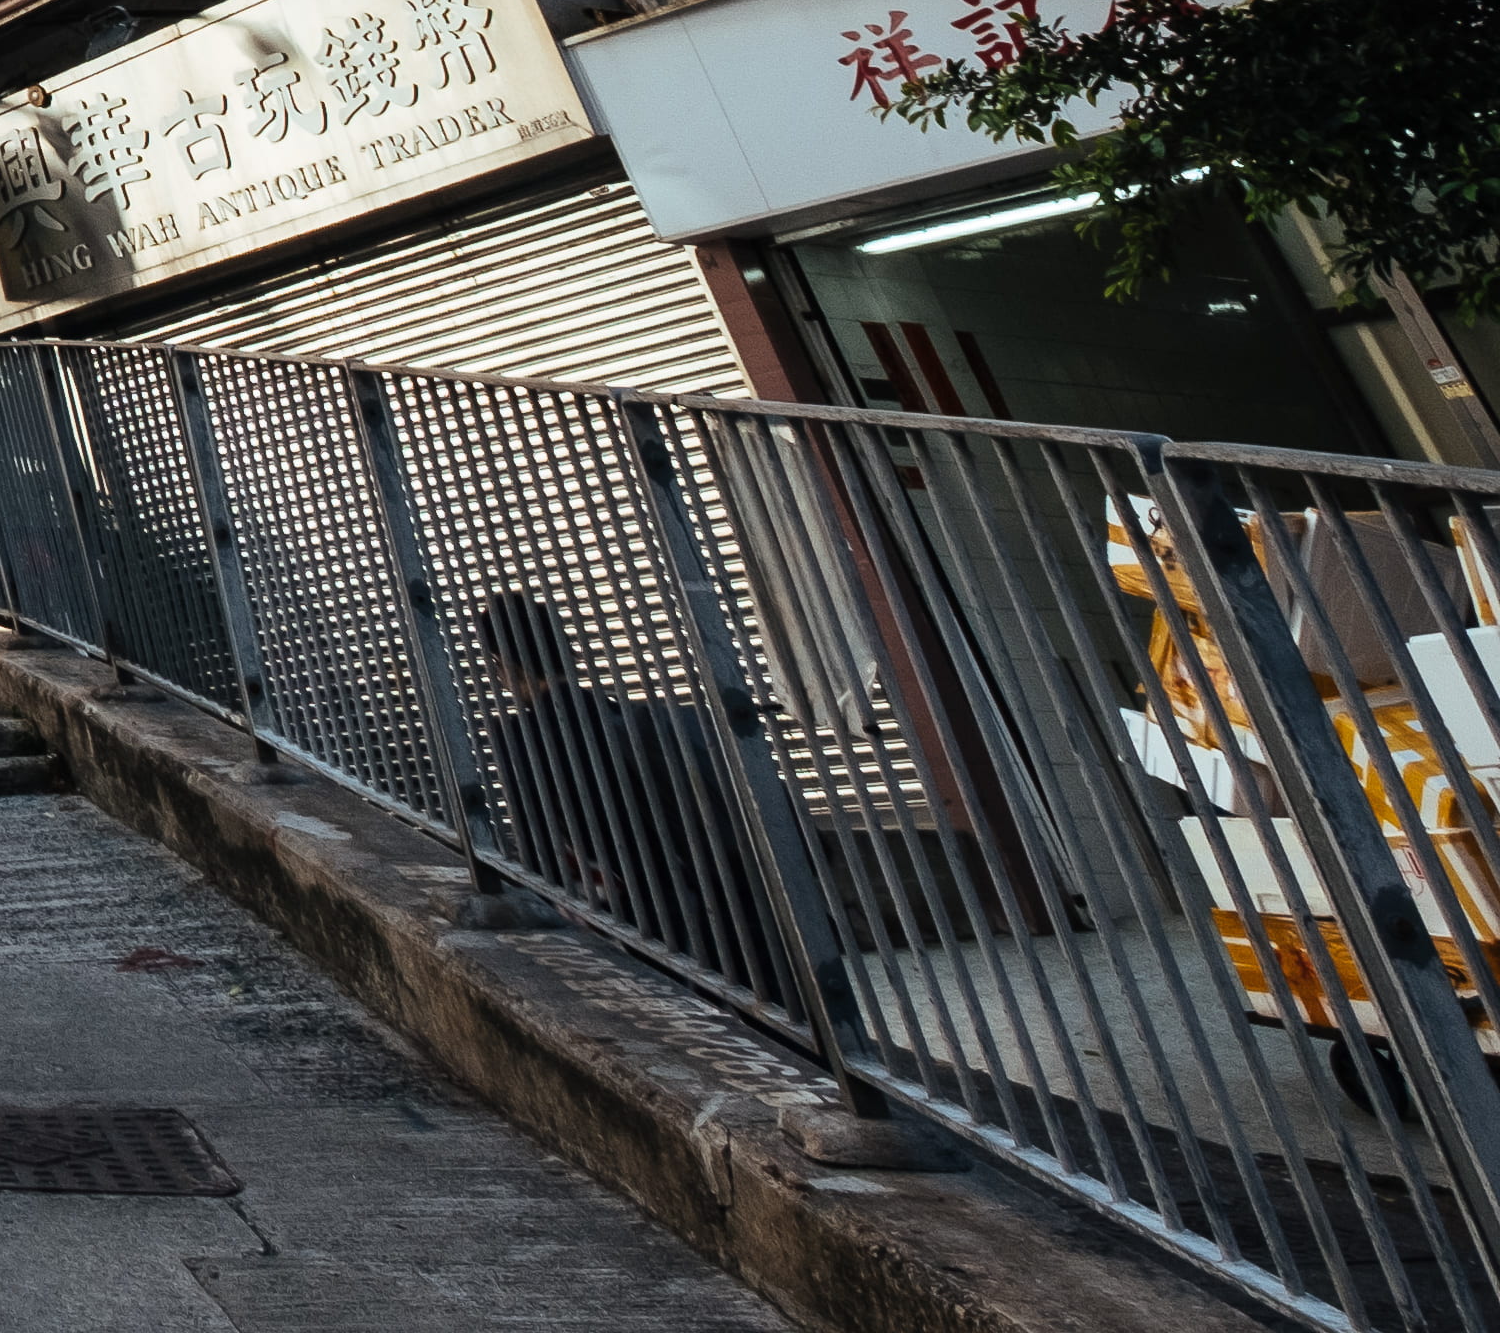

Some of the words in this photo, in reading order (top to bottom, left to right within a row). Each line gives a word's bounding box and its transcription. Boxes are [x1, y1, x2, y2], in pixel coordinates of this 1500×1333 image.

[19, 241, 93, 290] HING
[105, 210, 181, 260] WAH
[197, 154, 348, 231] ANTIQUE
[360, 96, 517, 173] TRADER
